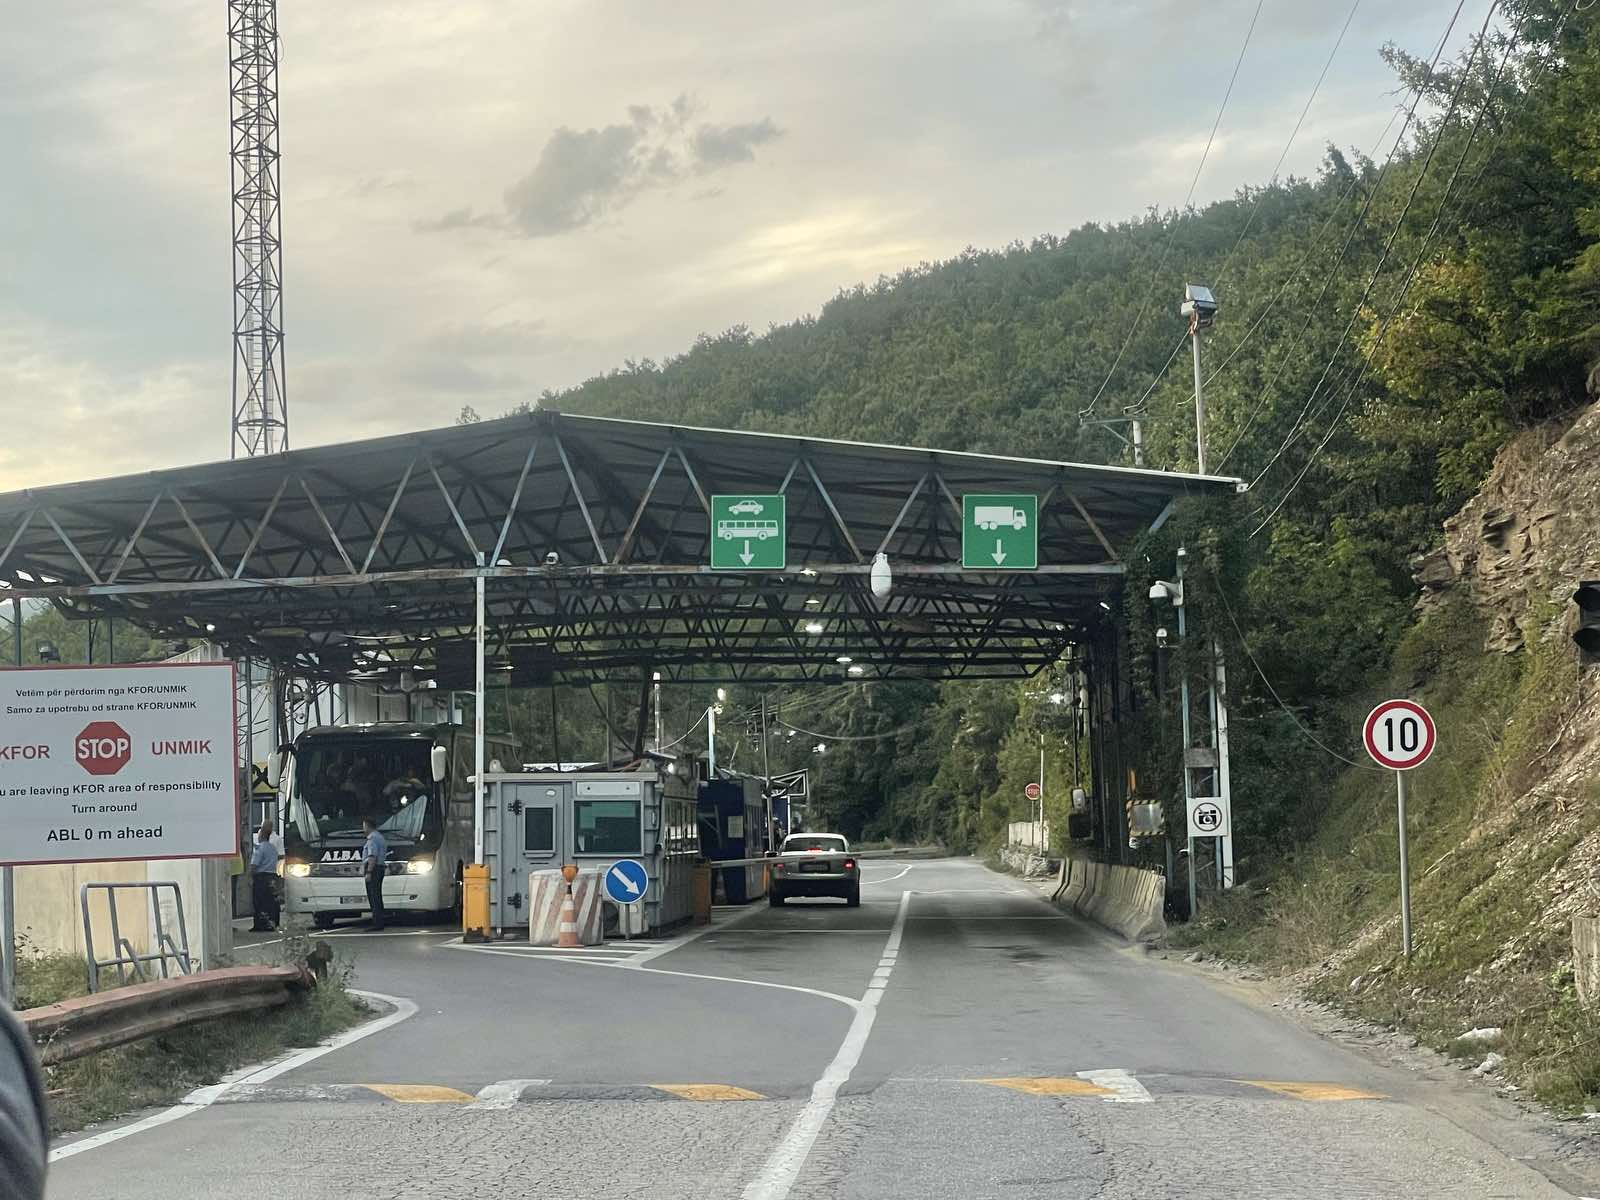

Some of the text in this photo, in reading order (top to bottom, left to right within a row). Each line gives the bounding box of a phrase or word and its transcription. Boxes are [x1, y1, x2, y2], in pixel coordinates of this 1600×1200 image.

[15, 685, 187, 699] Vetëm për përdorim nga KFOR/UNMIK
[6, 706, 33, 714] Samo
[48, 704, 89, 714] upotrebu
[92, 704, 103, 712] od
[137, 701, 197, 710] KFOR/UNMIK
[1385, 717, 1418, 752] 10
[0, 745, 50, 760] KFOR
[78, 738, 129, 759] STOP
[152, 740, 212, 756] UNMIK
[9, 788, 26, 796] are
[30, 785, 69, 796] leaving
[73, 784, 105, 794] KFOR
[108, 785, 131, 793] area
[134, 782, 146, 792] of
[148, 780, 221, 792] responsibility
[72, 802, 138, 814] Turn around
[47, 828, 80, 841] ABL
[98, 830, 112, 839] m
[117, 825, 163, 839] ahead
